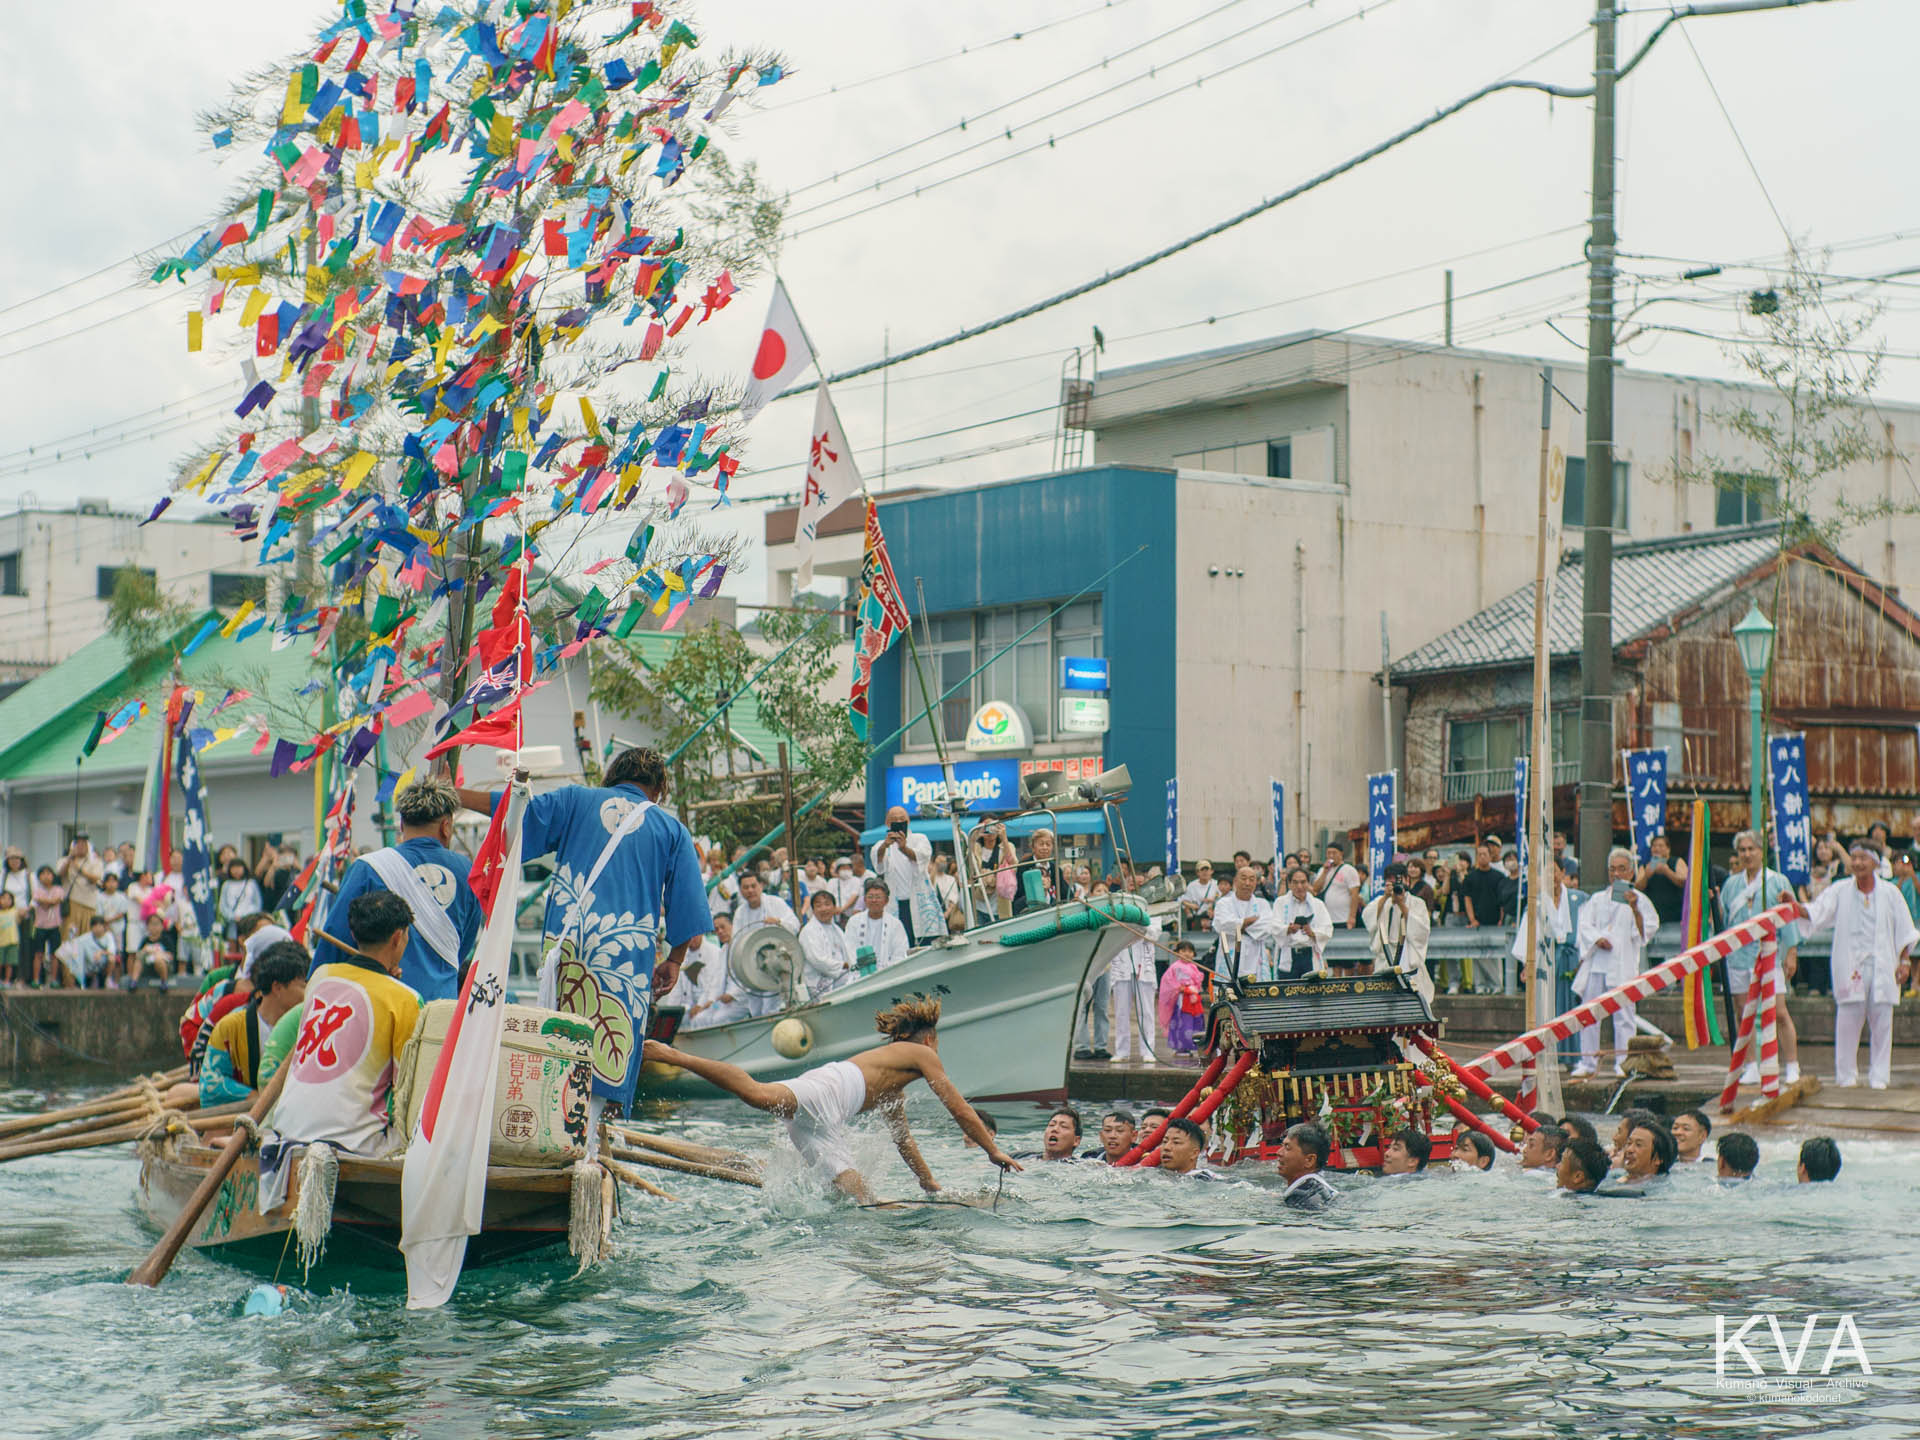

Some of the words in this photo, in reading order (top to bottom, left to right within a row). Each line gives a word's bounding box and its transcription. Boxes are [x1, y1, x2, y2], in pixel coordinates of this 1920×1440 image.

[296, 997, 354, 1068] 祝
[504, 1017, 539, 1034] 登録
[506, 1052, 525, 1101] 皆兄弟
